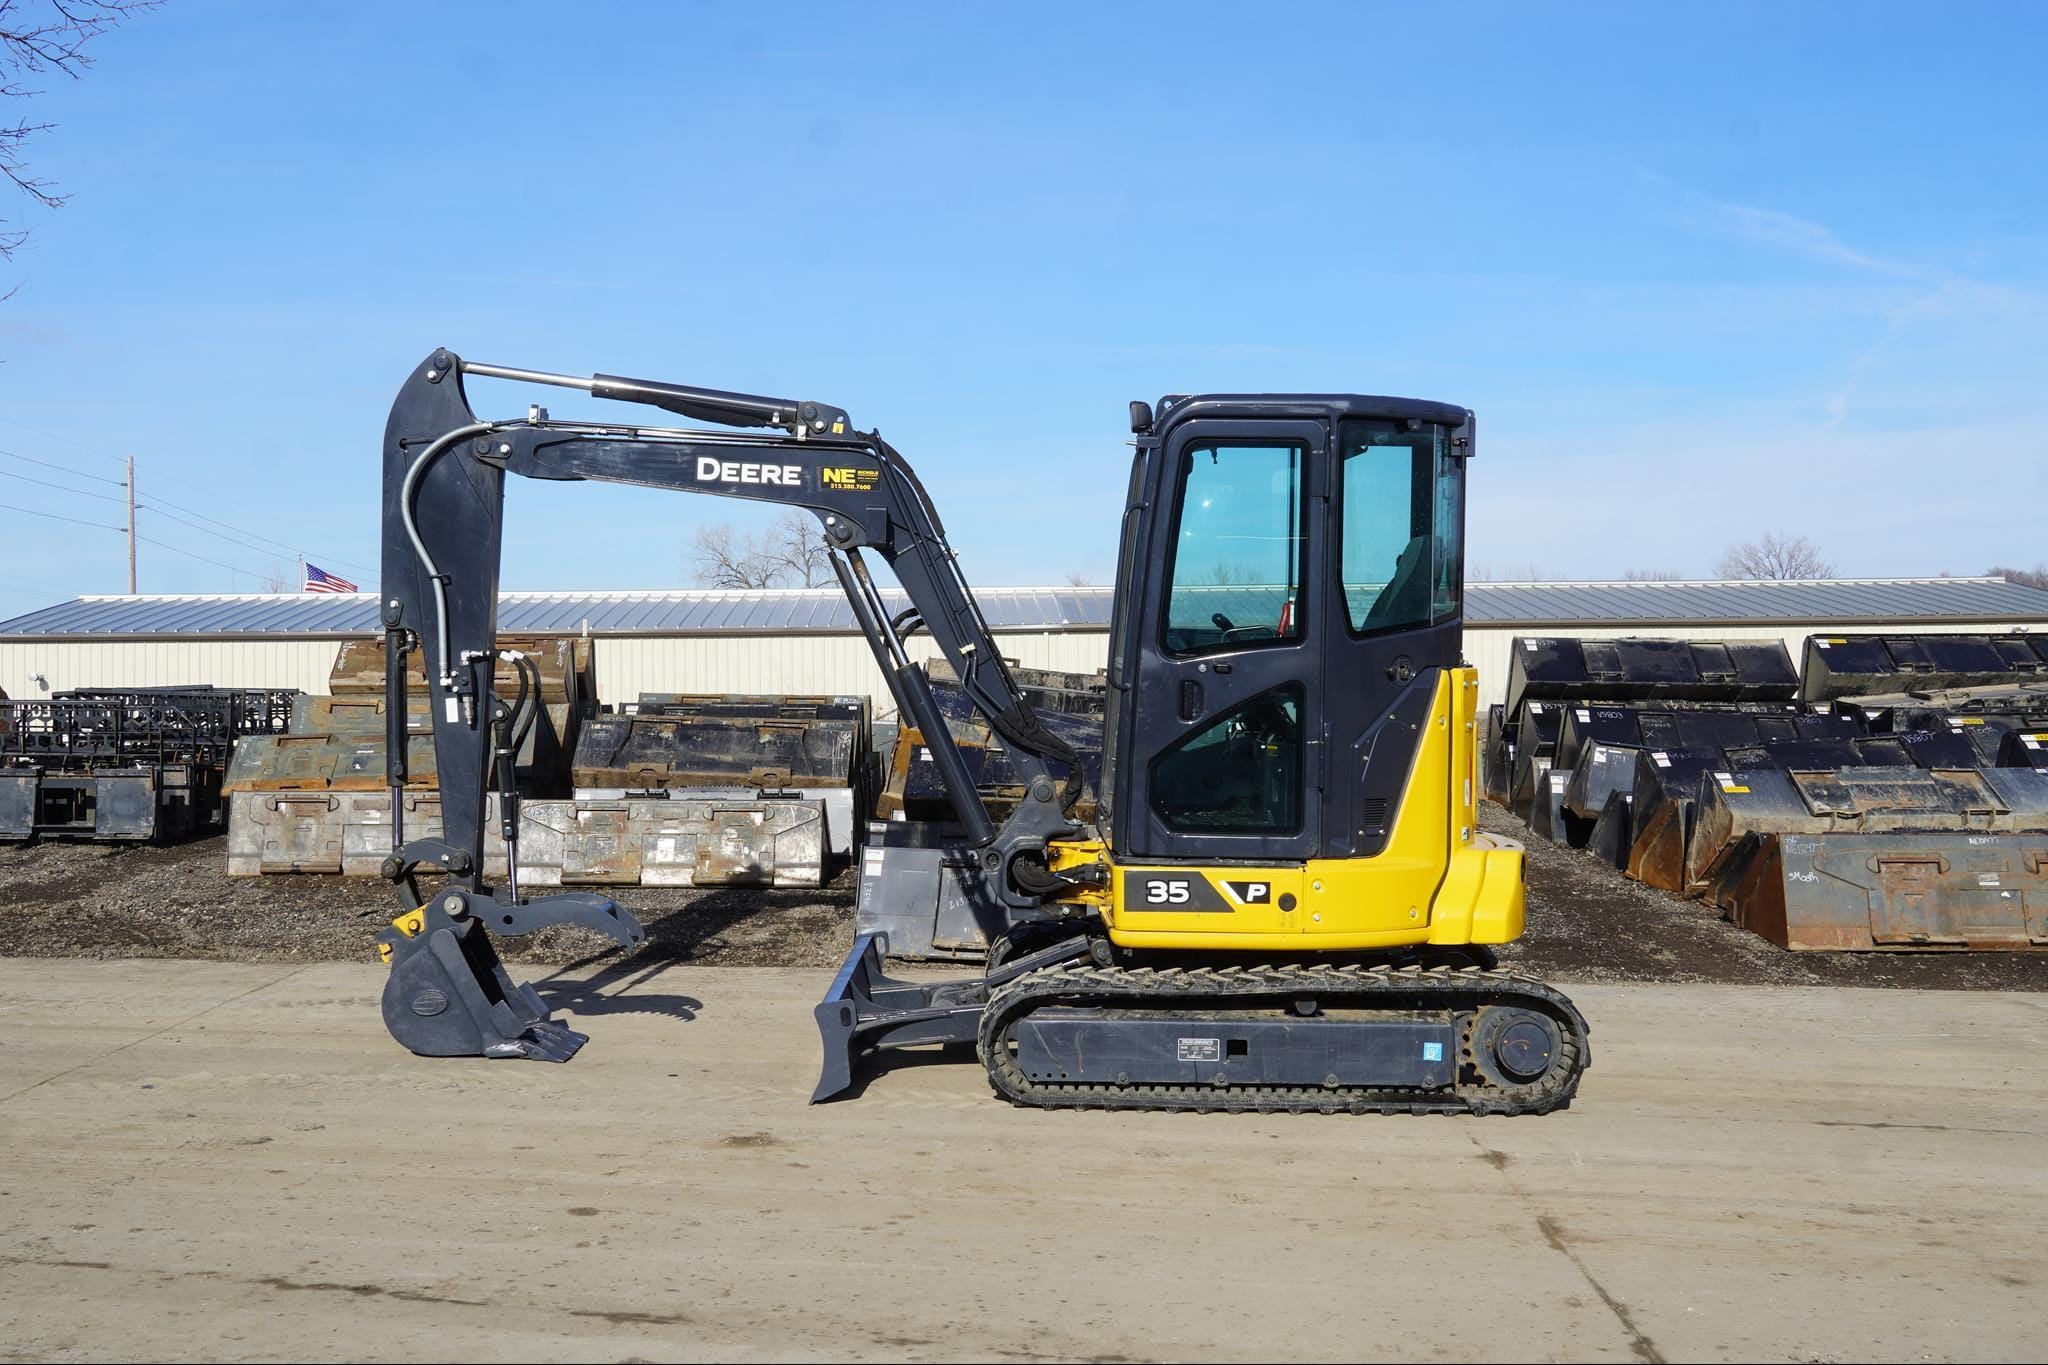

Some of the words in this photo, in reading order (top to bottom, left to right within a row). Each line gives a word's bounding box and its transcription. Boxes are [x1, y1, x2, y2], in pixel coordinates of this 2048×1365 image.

[697, 456, 801, 485] DEERE
[823, 468, 856, 483] NE
[1147, 881, 1190, 903] 35
[1246, 884, 1267, 902] P
